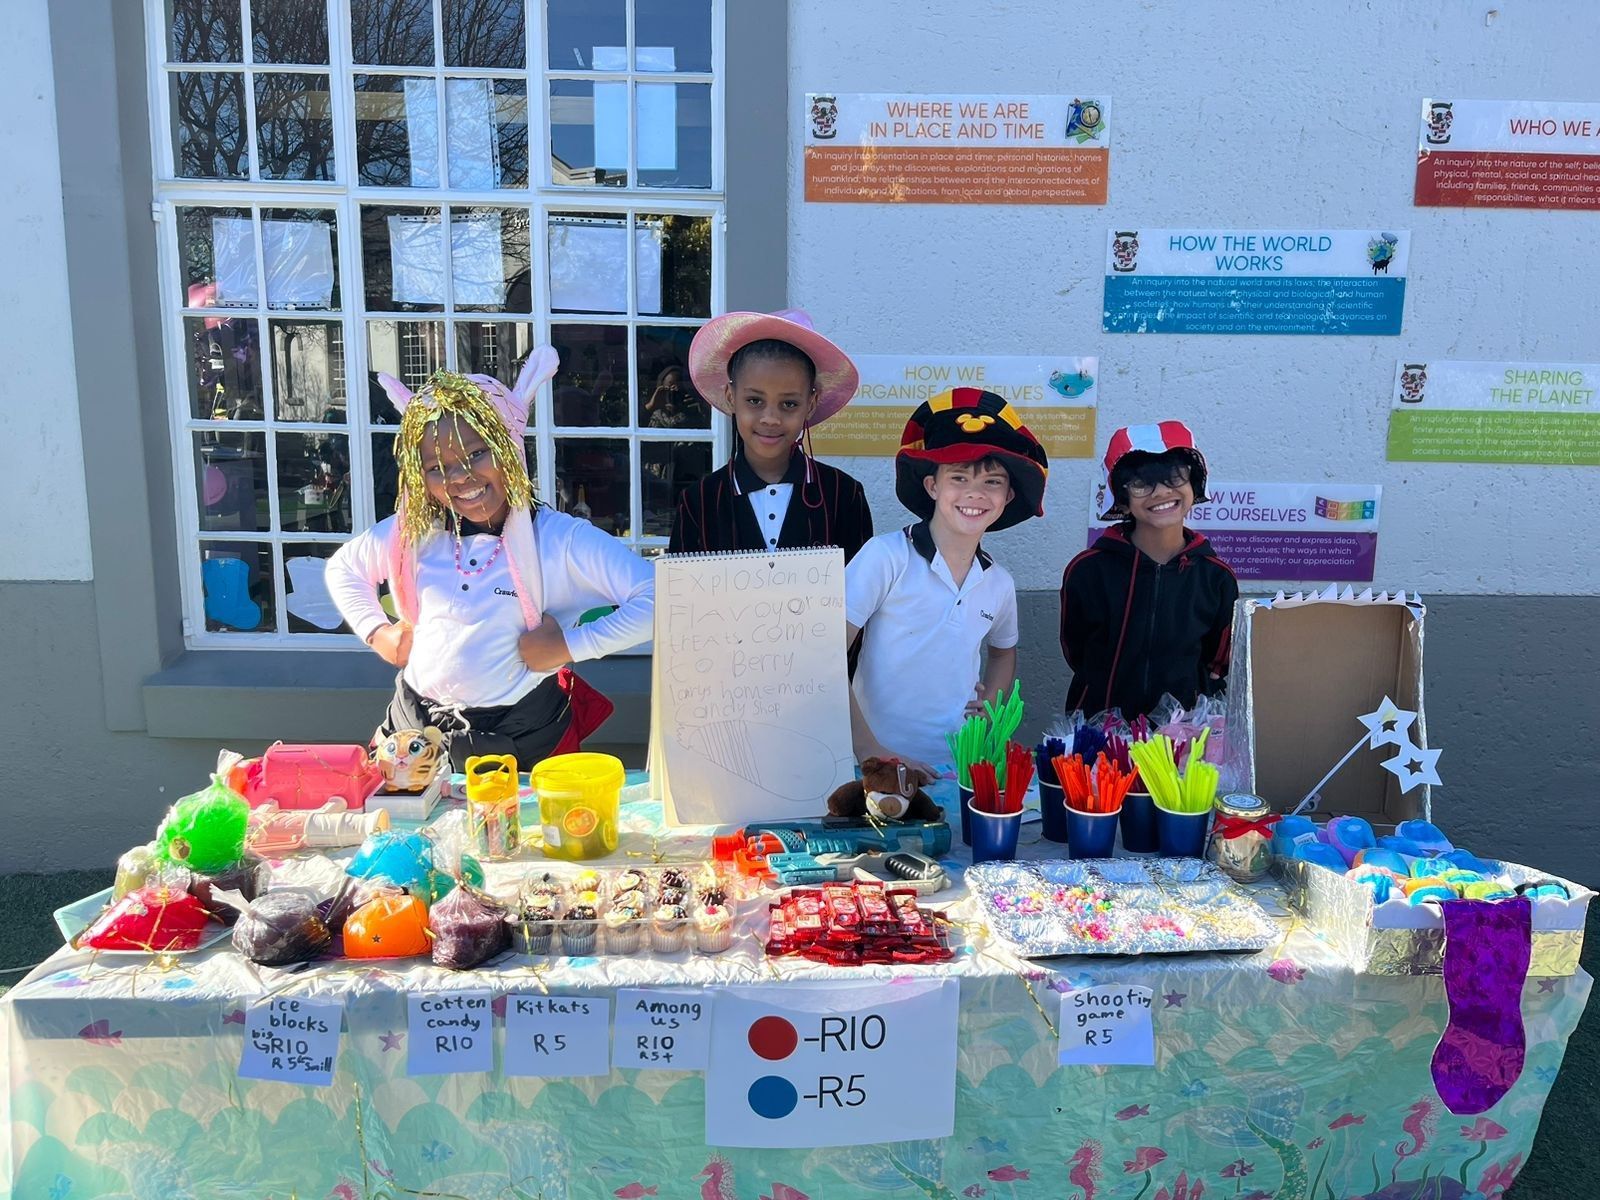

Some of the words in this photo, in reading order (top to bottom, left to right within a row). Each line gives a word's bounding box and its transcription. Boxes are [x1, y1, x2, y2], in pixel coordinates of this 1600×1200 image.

[887, 102, 952, 119] WHERE
[959, 103, 989, 119] WE
[994, 103, 1028, 119] ARE
[870, 123, 887, 137] IN
[894, 123, 951, 138] PLACE
[957, 123, 997, 139] AND
[1003, 123, 1044, 139] TIME
[1510, 119, 1556, 135] WHO
[1563, 121, 1591, 136] WE
[872, 152, 918, 160] orientation
[920, 152, 928, 160] in
[930, 152, 954, 161] place
[998, 153, 1034, 162] personal
[1447, 159, 1474, 167] inquiry
[1477, 159, 1492, 167] into
[1495, 159, 1508, 167] the
[888, 164, 902, 172] the
[1009, 165, 1024, 173] and
[1027, 166, 1071, 174] migrations
[1434, 170, 1469, 179] physical,
[1472, 171, 1503, 179] mental,
[1505, 171, 1528, 179] social
[1550, 173, 1581, 181] spiritual
[934, 176, 970, 184] between
[973, 176, 989, 184] and
[992, 176, 1005, 184] the
[1436, 181, 1474, 190] including
[1476, 182, 1509, 191] families,
[1511, 182, 1540, 191] friends,
[1543, 184, 1593, 192] communities
[1170, 236, 1216, 251] HOW
[1223, 236, 1256, 251] THE
[1263, 236, 1331, 251] WORLD
[1216, 256, 1283, 271] WORKS
[1144, 279, 1171, 287] inquiry
[1273, 290, 1289, 298] and
[1356, 290, 1384, 298] human
[1337, 301, 1373, 309] scientific
[1185, 324, 1215, 332] society
[905, 366, 950, 381] HOW
[957, 366, 985, 381] WE
[1504, 369, 1583, 385] SHARING
[943, 384, 1044, 400] ELVES
[1490, 388, 1522, 403] THE
[1528, 389, 1593, 404] PLANET
[1230, 492, 1256, 504] WE
[1216, 508, 1306, 522] OURSELVES
[1302, 537, 1332, 545] express
[1334, 537, 1358, 545] ideas,
[1253, 546, 1280, 554] values;
[1247, 557, 1286, 565] creativity;
[1303, 558, 1354, 566] appreciation
[665, 656, 714, 682] to
[732, 650, 794, 678] Berry
[721, 679, 826, 702] homemade
[421, 996, 486, 1013] Cotten
[636, 1000, 701, 1020] Among
[270, 1013, 328, 1033] blocks
[427, 1013, 480, 1032] candy
[651, 1016, 680, 1029] us
[1077, 1009, 1124, 1027] game
[252, 1028, 274, 1039] big
[271, 1038, 308, 1055] R10
[436, 1036, 473, 1053] R10
[637, 1036, 674, 1050] R10
